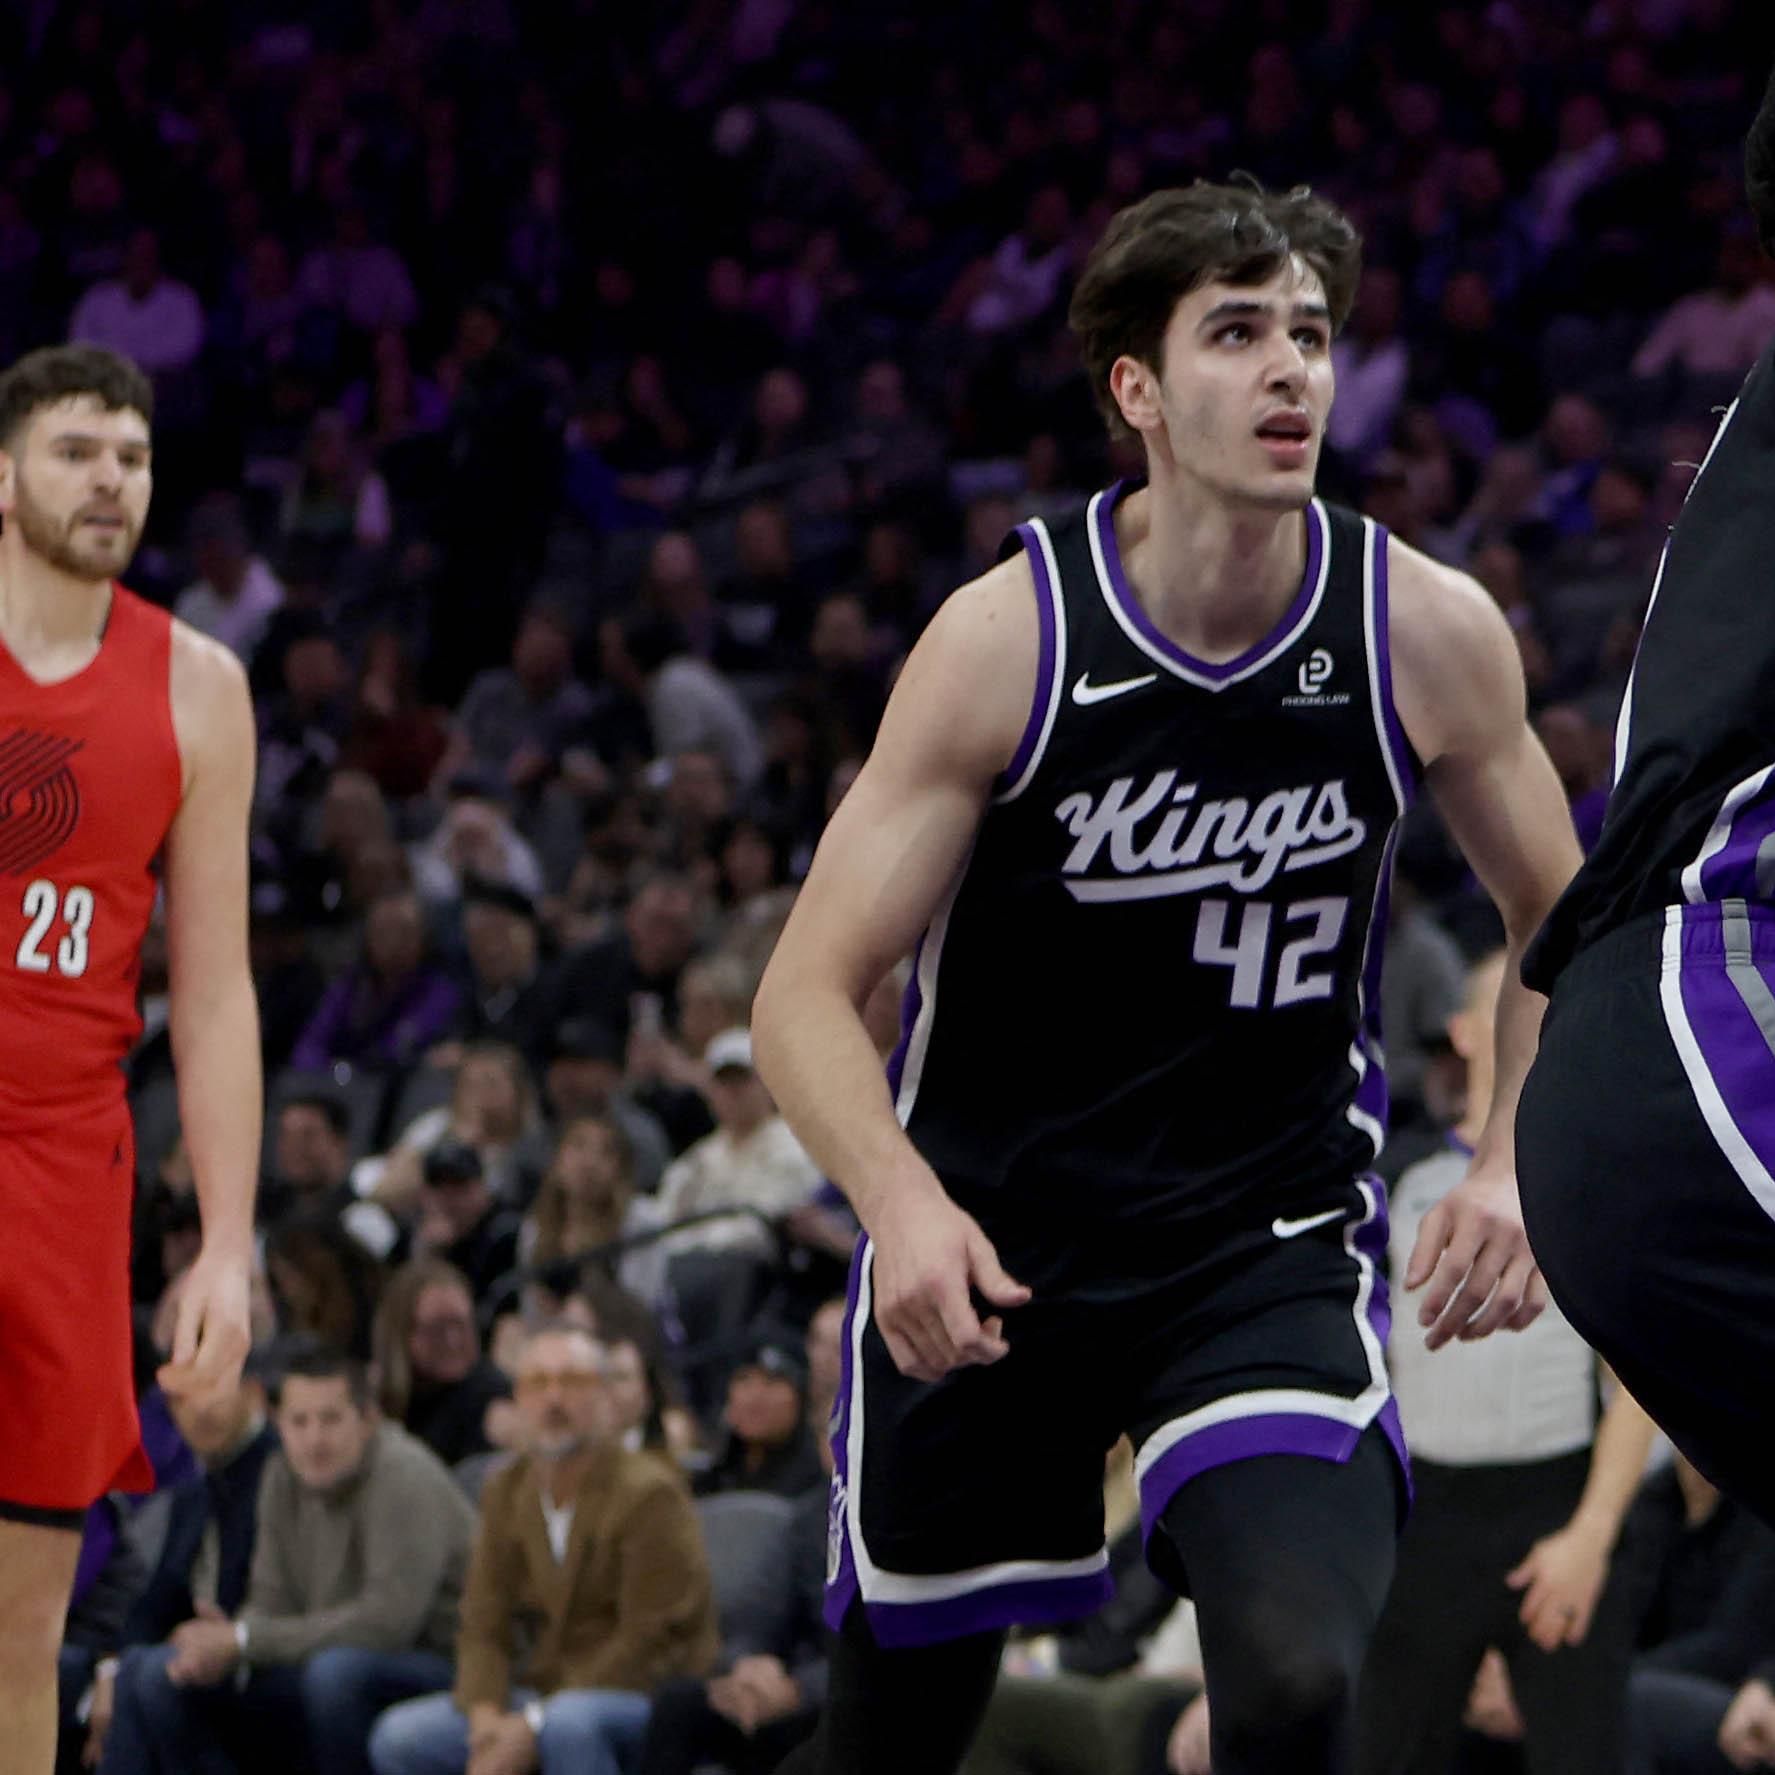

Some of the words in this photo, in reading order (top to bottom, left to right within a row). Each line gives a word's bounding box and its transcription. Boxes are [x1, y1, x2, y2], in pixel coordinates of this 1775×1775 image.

[1053, 768, 1367, 904] Kings
[15, 878, 96, 979] 23
[1192, 896, 1349, 1009] 42
